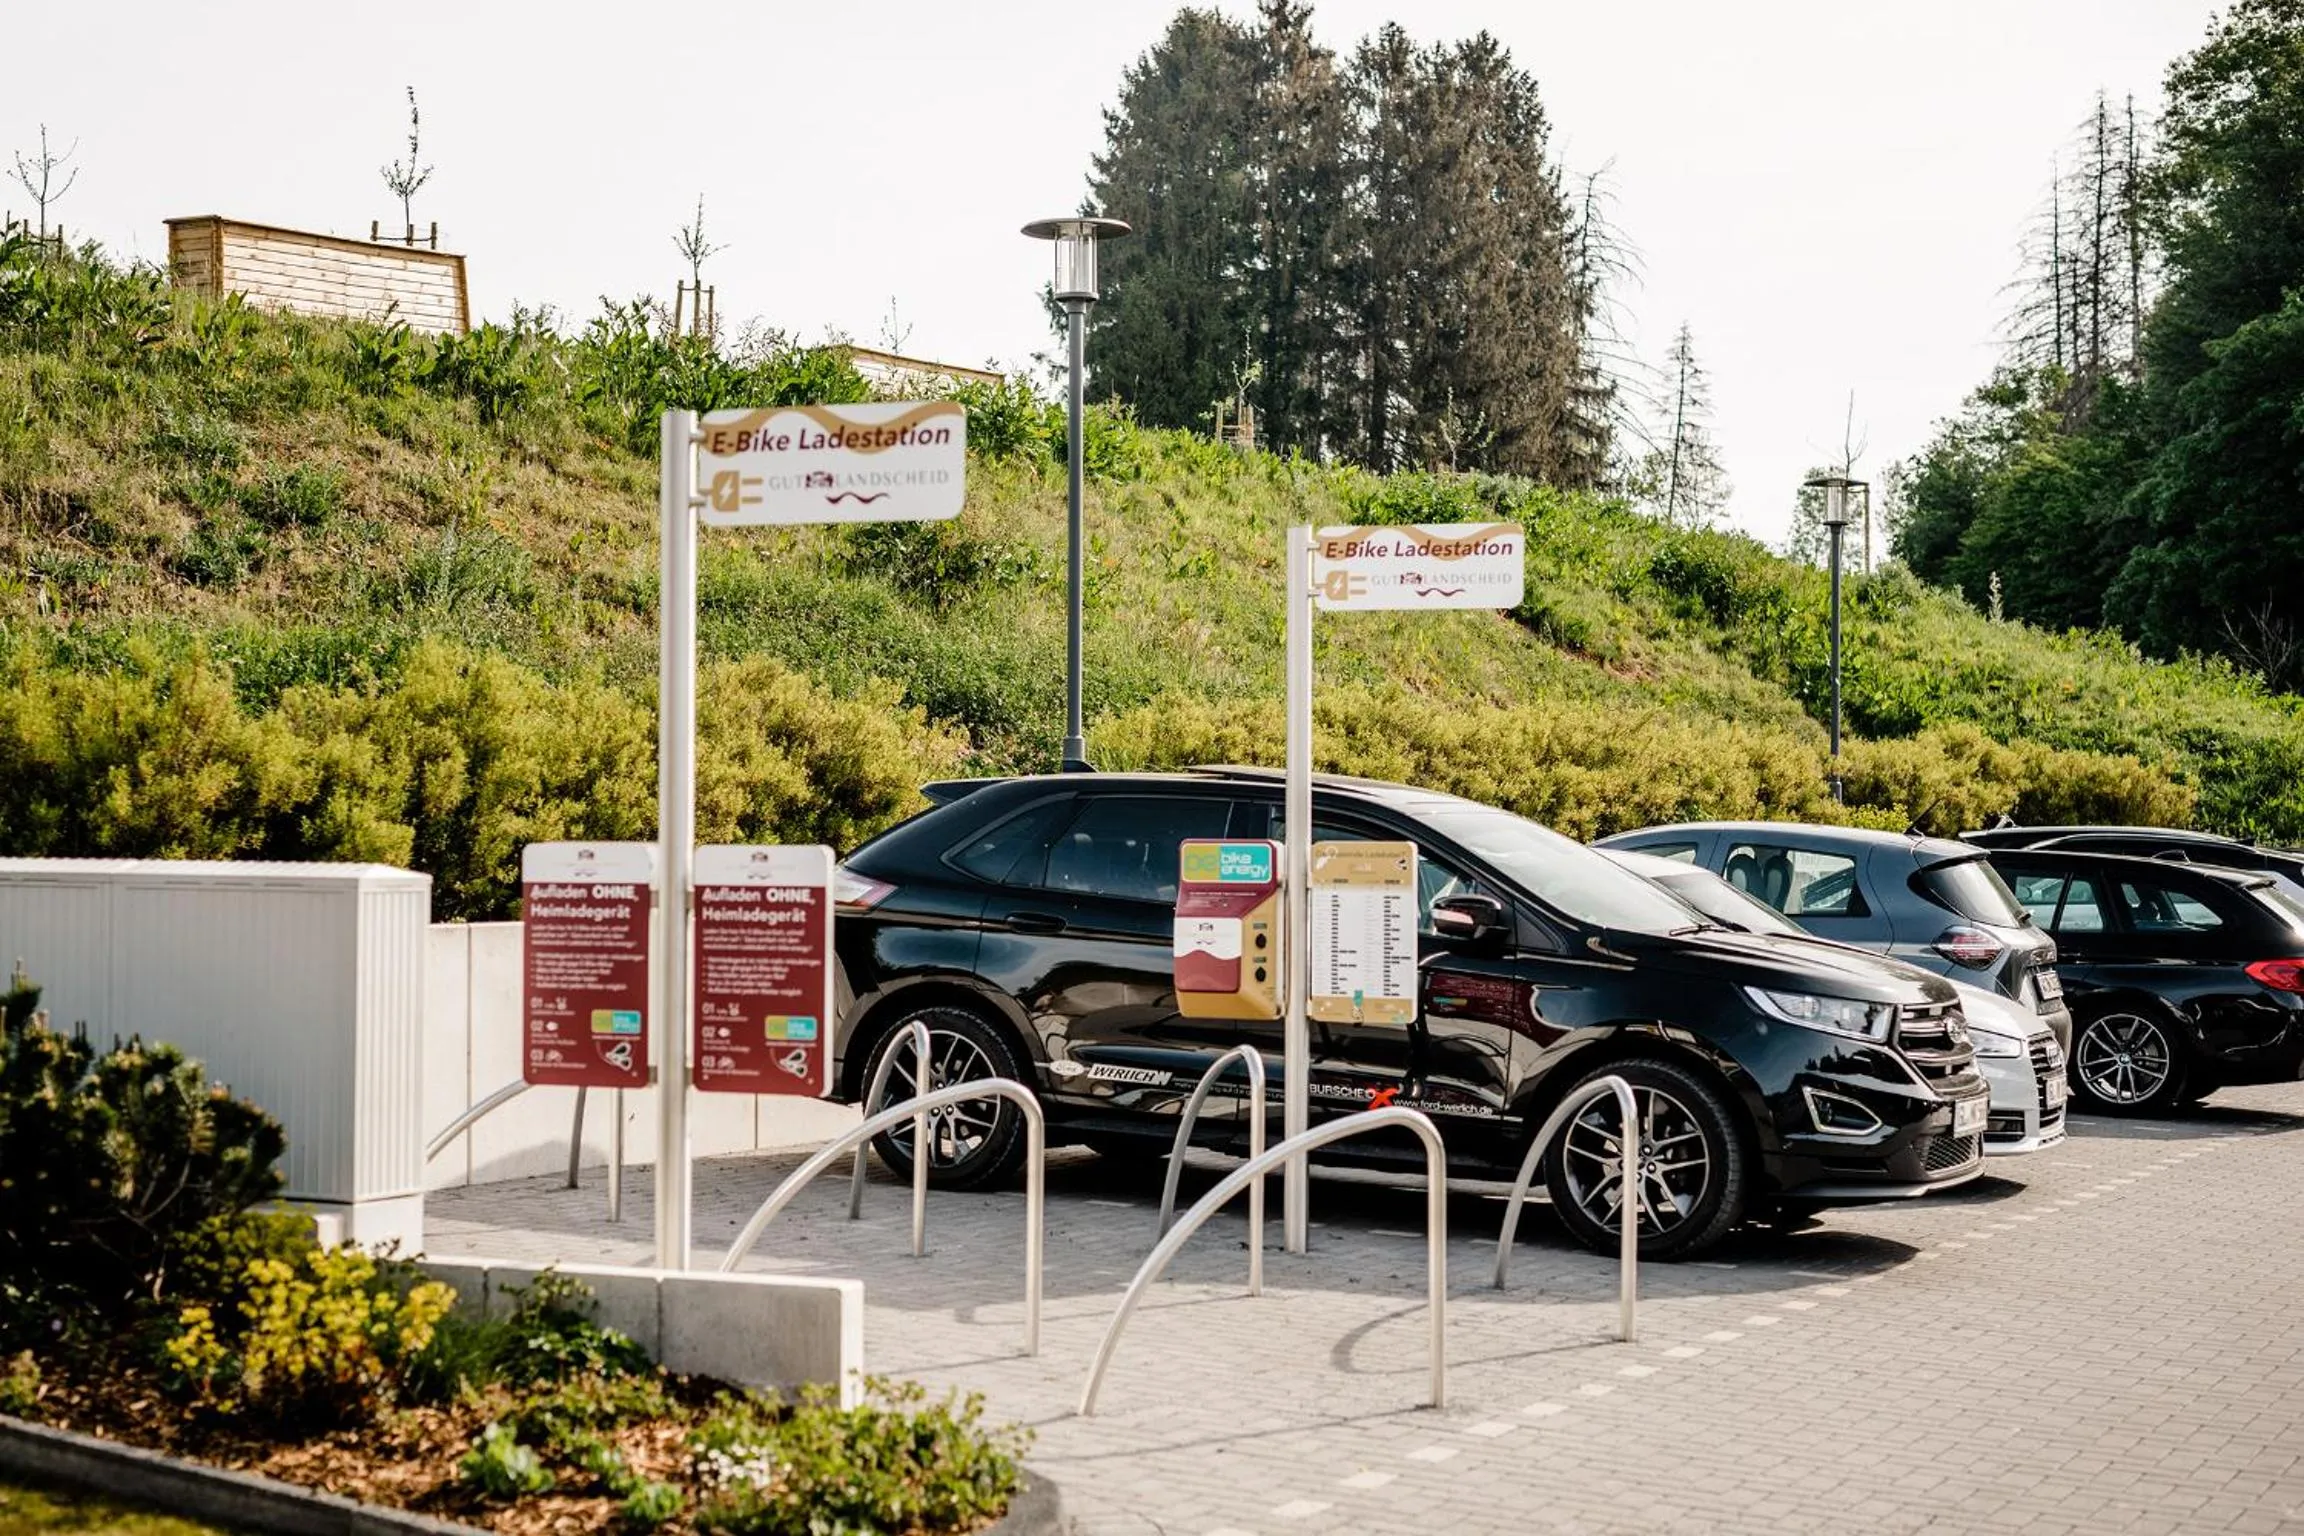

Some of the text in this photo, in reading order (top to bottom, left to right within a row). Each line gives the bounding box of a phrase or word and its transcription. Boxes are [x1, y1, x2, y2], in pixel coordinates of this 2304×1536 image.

[711, 423, 951, 454] E-Bike Ladestation
[836, 468, 949, 489] LANDSCHEID
[1324, 538, 1513, 558] E-Bike Ladestation
[1422, 571, 1513, 585] LANDSCHEID
[1220, 851, 1252, 865] bike
[1220, 865, 1269, 879] energy
[530, 884, 587, 900] Aufladen
[702, 887, 761, 903] Aufladen
[530, 903, 631, 922] Heimladegerät
[702, 906, 807, 925] Heimladegerät
[1392, 1098, 1494, 1115] www.ford-werlich.de
